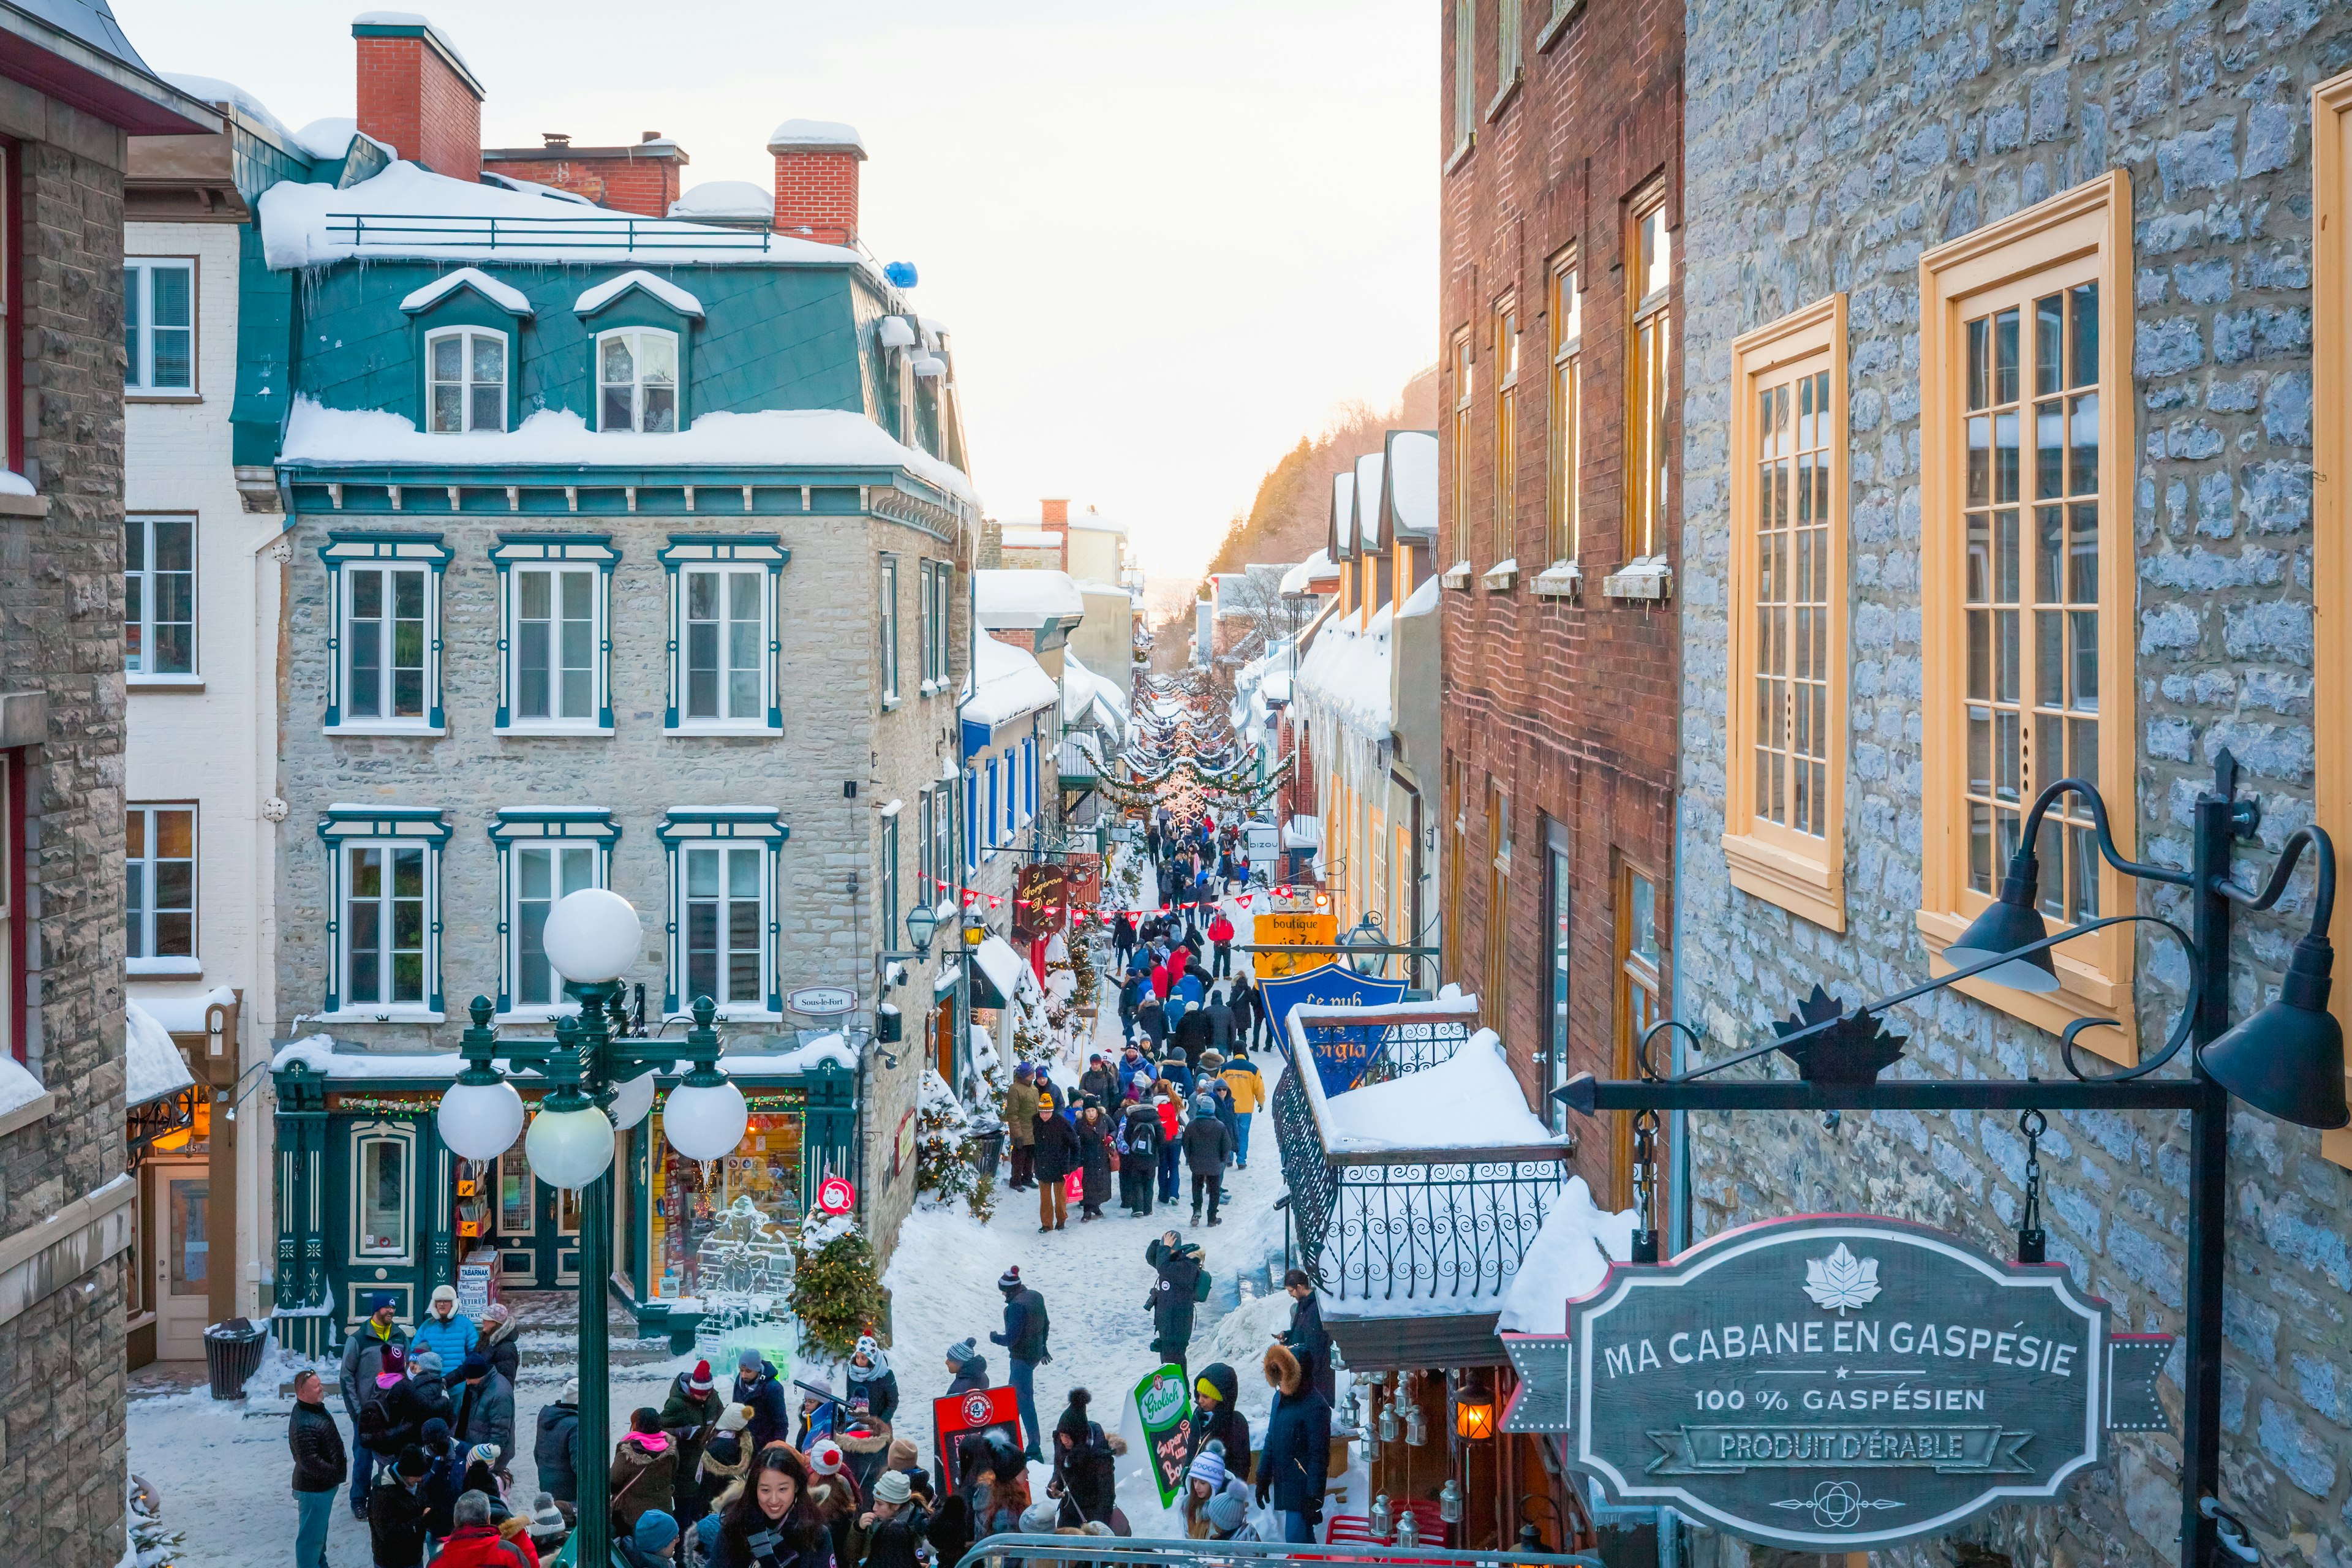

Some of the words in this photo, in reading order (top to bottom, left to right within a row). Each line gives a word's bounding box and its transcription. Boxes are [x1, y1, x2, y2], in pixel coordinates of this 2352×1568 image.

[1250, 837, 1278, 848] bizou
[1022, 877, 1063, 900] Forgeron
[1273, 918, 1317, 932] boutique
[1604, 1338, 1662, 1379] MA
[1668, 1321, 1822, 1363] CABANE
[1834, 1321, 1880, 1352] EN
[1889, 1319, 2079, 1378] GASPÉSIE
[965, 1395, 991, 1414] ST-AMBROISE
[1144, 1381, 1179, 1420] Grolsch
[1694, 1390, 1746, 1411] 100
[1755, 1390, 1789, 1411] %
[1803, 1381, 1986, 1411] GASPÉSIEN
[1157, 1433, 1183, 1458] Super
[1719, 1434, 1837, 1461] PRODUIT
[1839, 1431, 1965, 1461] D'ÉRABLE
